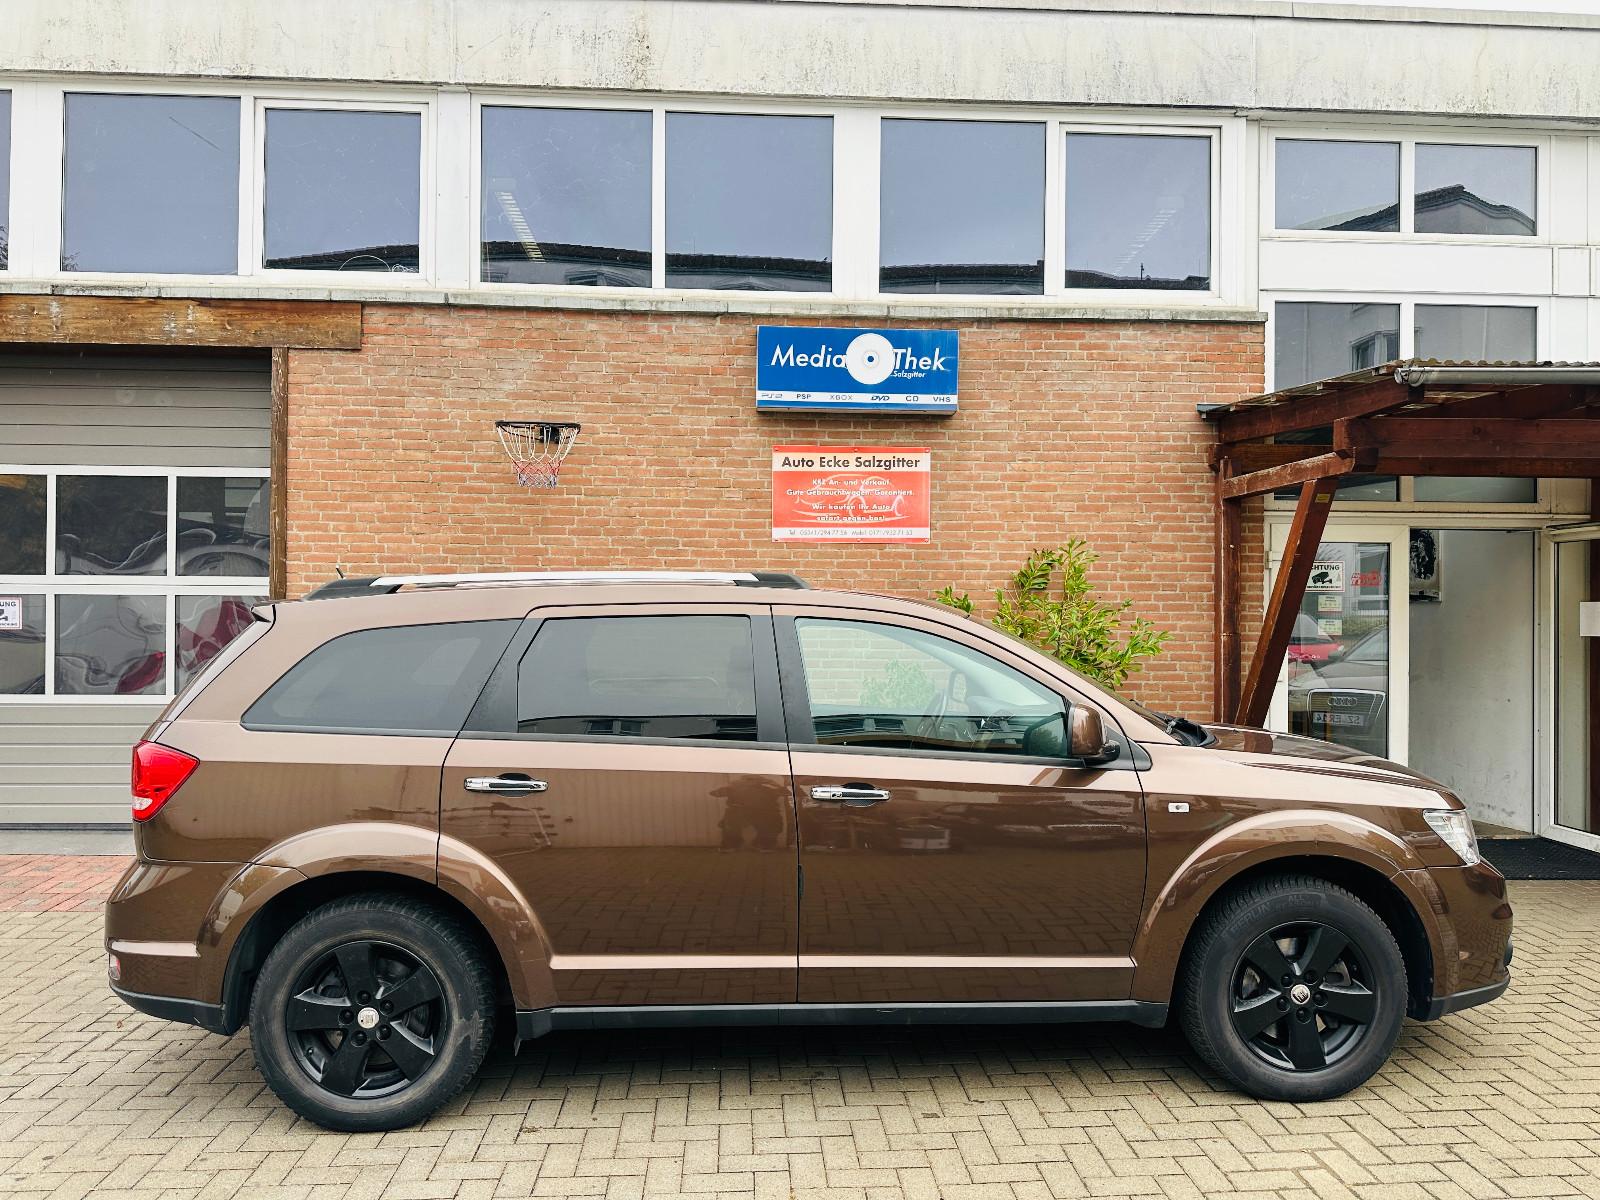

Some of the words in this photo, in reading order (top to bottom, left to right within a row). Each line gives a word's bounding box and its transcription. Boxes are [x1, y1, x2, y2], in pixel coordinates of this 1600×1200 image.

[770, 343, 848, 368] Media
[893, 347, 946, 371] Thek
[893, 370, 926, 379] Salzgitter
[781, 456, 815, 468] Auto
[819, 456, 850, 468] Ecke
[855, 456, 920, 471] Salzgitter
